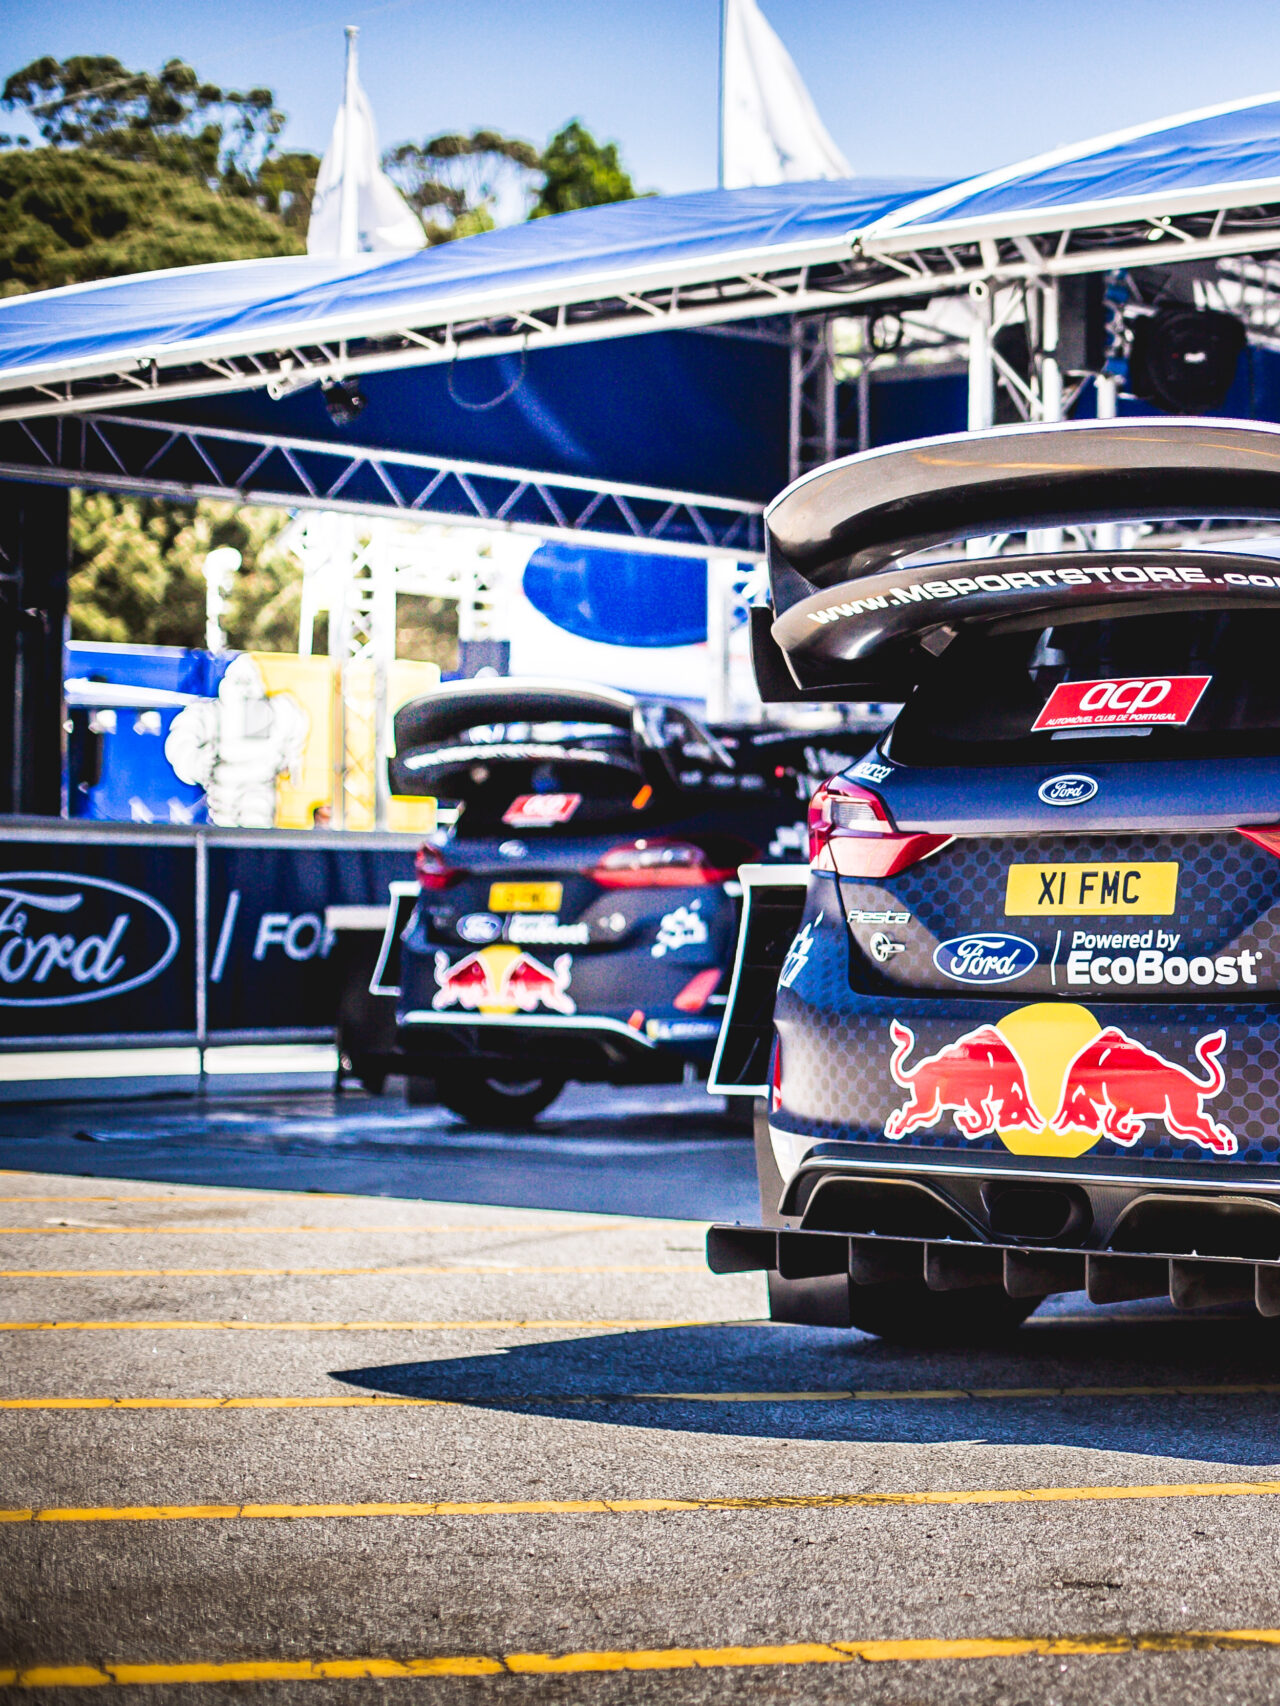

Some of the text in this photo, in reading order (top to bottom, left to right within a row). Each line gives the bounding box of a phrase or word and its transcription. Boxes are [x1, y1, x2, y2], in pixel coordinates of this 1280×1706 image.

[1094, 714, 1116, 723] CLUB
[1116, 713, 1129, 721] DE
[1129, 713, 1176, 721] PORTUGAL
[1050, 781, 1084, 798] Ford
[1079, 870, 1142, 905] FMC
[847, 909, 912, 923] Fiesta
[0, 888, 131, 983] Ford
[1071, 930, 1181, 951] Powered by
[950, 939, 1020, 975] Ford
[1066, 950, 1259, 985] EcoBoost
